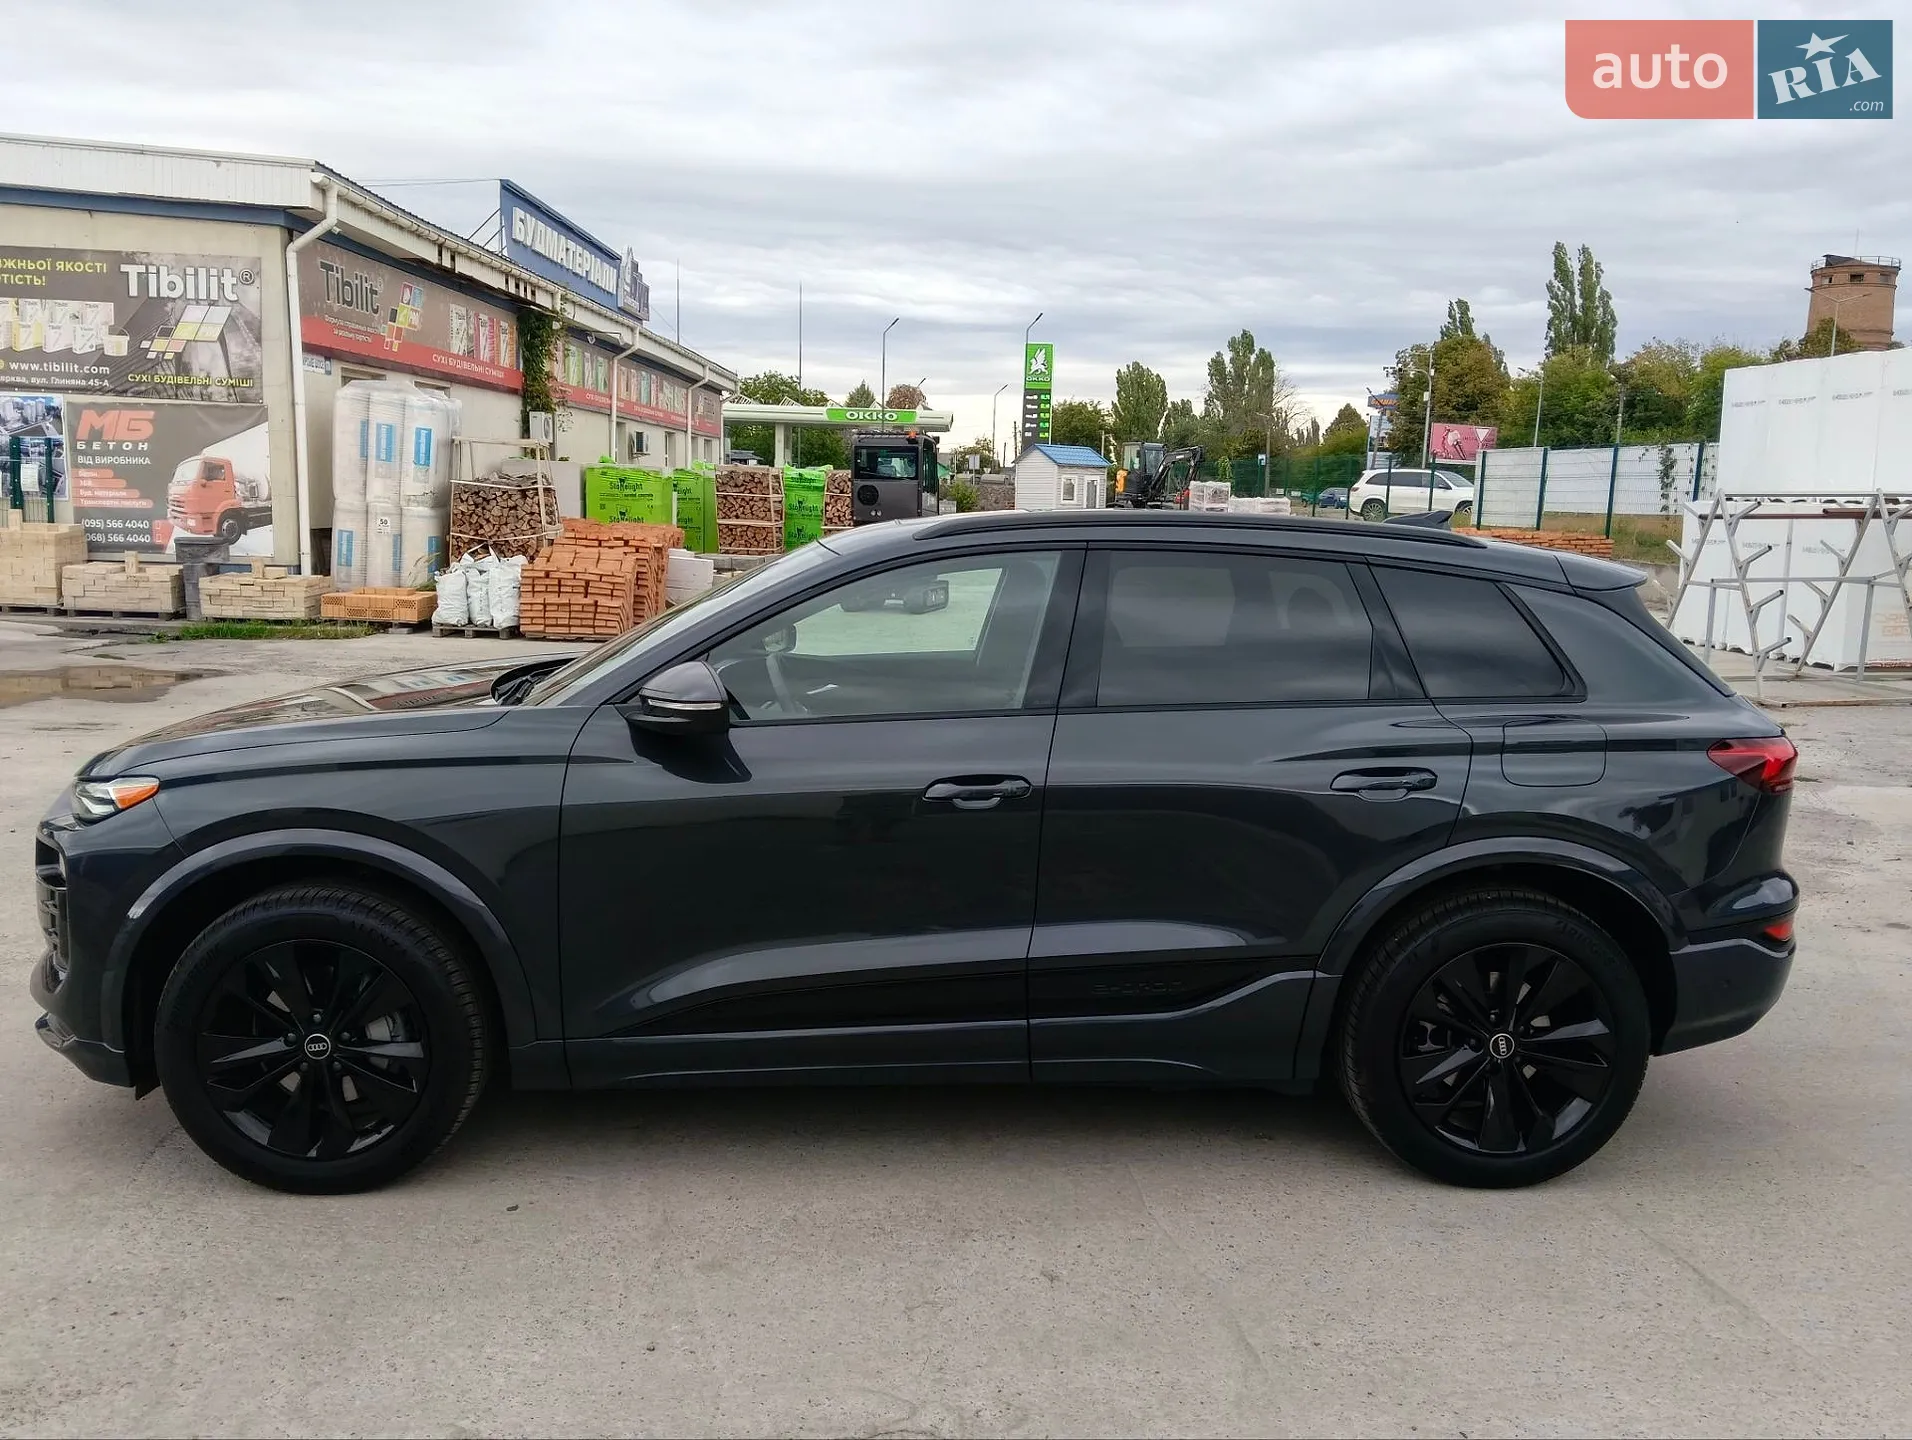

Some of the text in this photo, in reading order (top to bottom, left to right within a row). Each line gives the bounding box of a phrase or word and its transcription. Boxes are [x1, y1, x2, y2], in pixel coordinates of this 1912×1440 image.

[512, 206, 617, 295] БУДМАТЕРІАЛИ
[56, 261, 107, 273] ЯКОСТІ
[0, 274, 46, 286] ТІСТЬ!
[9, 361, 110, 375] www.tibilit.com
[128, 374, 253, 387] СУХІ БУДІВЕЛЬНІ СУМІШІ
[76, 441, 149, 451] БЕТОН
[78, 455, 152, 465] ВІД ВИРОБНИКА
[82, 519, 150, 529] (095) 566 4040
[85, 533, 151, 543] 068) 566 4040
